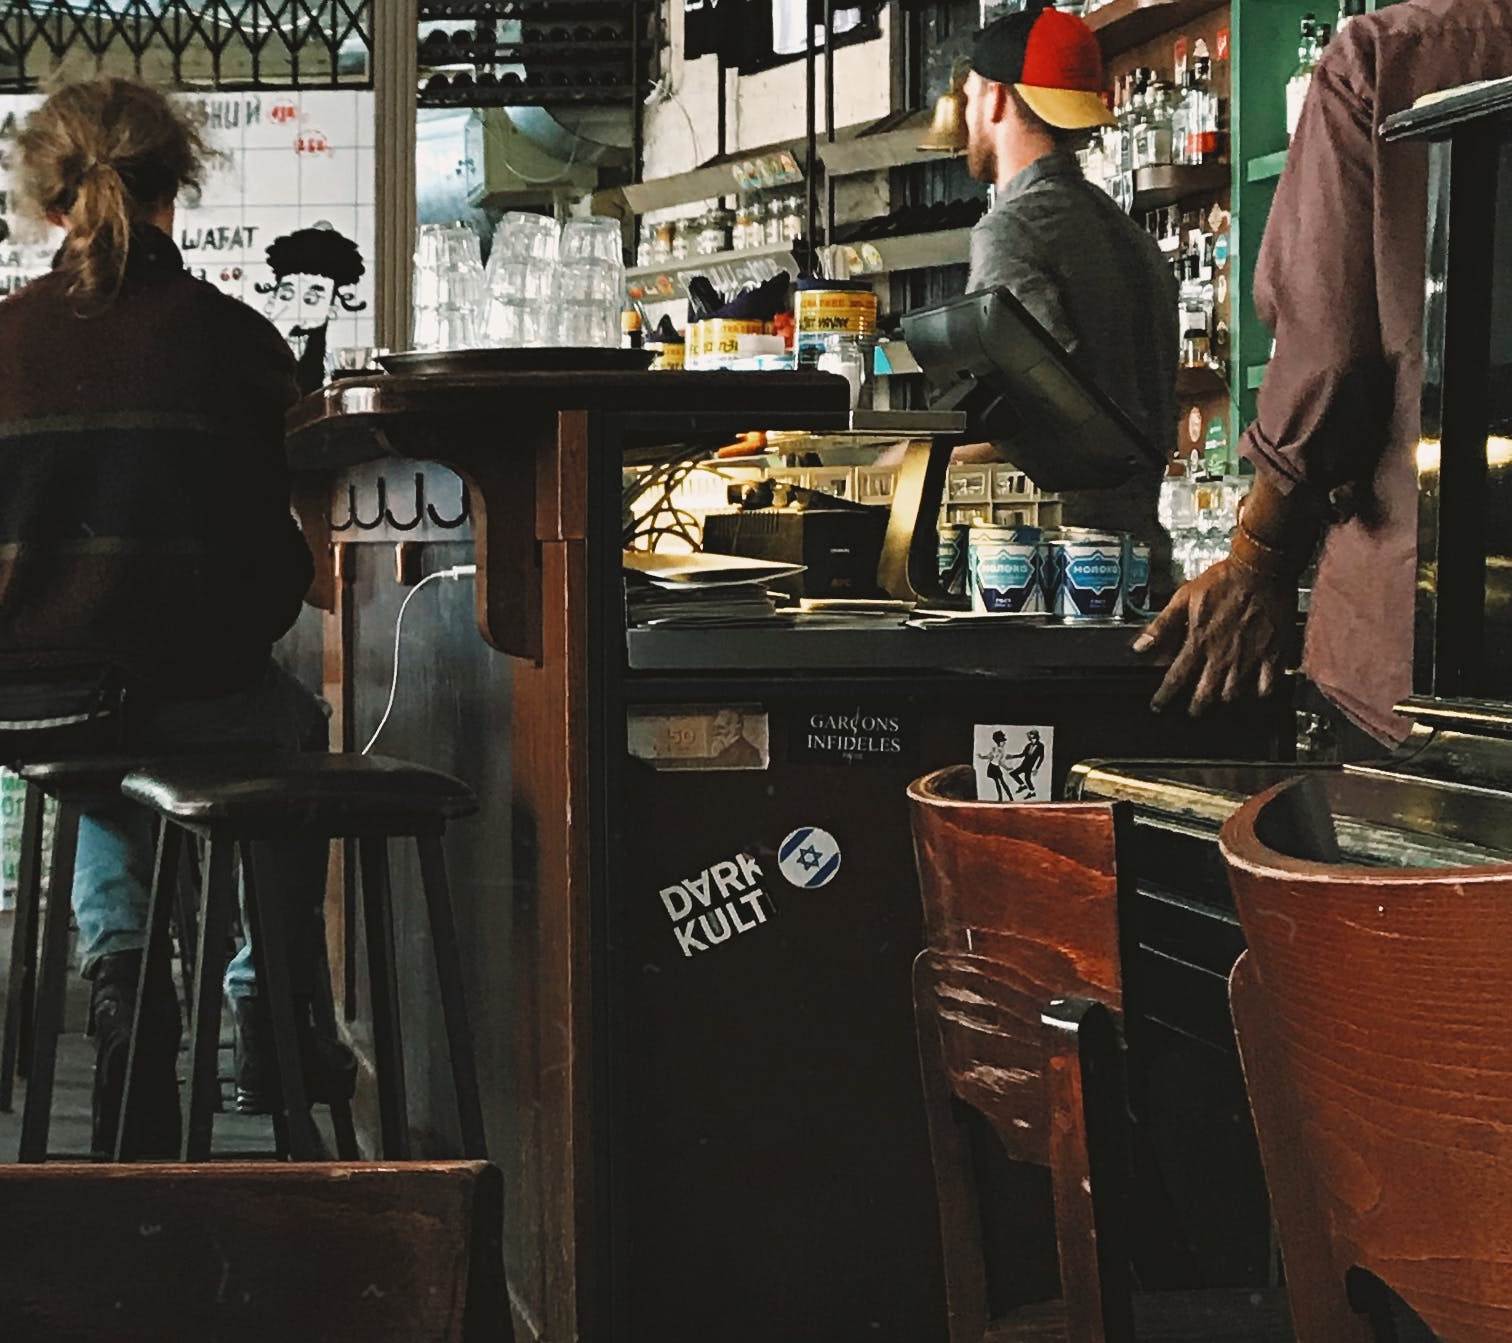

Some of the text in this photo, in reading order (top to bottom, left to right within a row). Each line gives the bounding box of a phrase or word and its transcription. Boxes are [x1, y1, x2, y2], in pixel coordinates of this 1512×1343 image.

[182, 226, 259, 250] ШАБАТ
[1073, 564, 1118, 574] МОЛОКО
[659, 853, 763, 922] DARK
[673, 888, 767, 956] KULT
